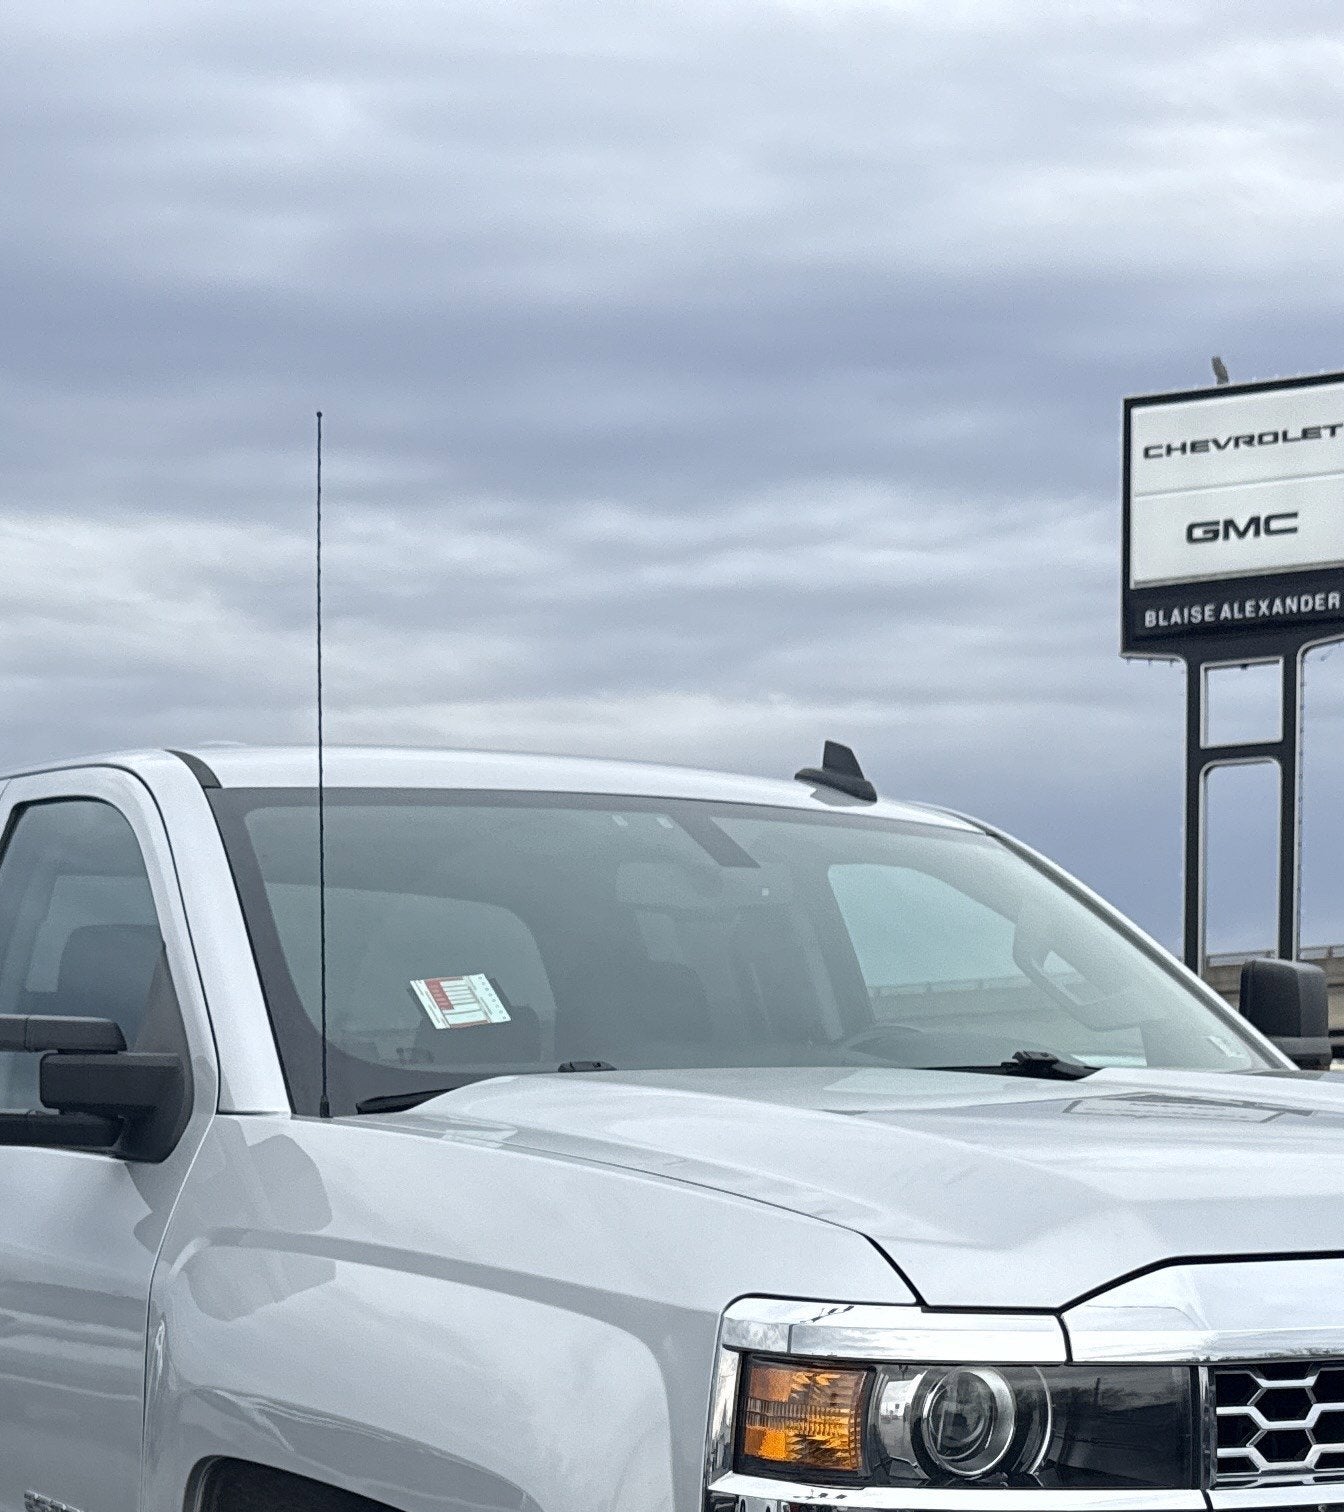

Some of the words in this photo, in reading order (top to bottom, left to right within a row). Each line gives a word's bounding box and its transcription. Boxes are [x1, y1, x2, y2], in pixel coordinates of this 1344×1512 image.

[1143, 422, 1344, 460] CHEVROLET
[1186, 511, 1299, 545] GMC
[1144, 603, 1217, 629] BLAISE
[1220, 591, 1341, 620] ALEXANDER
